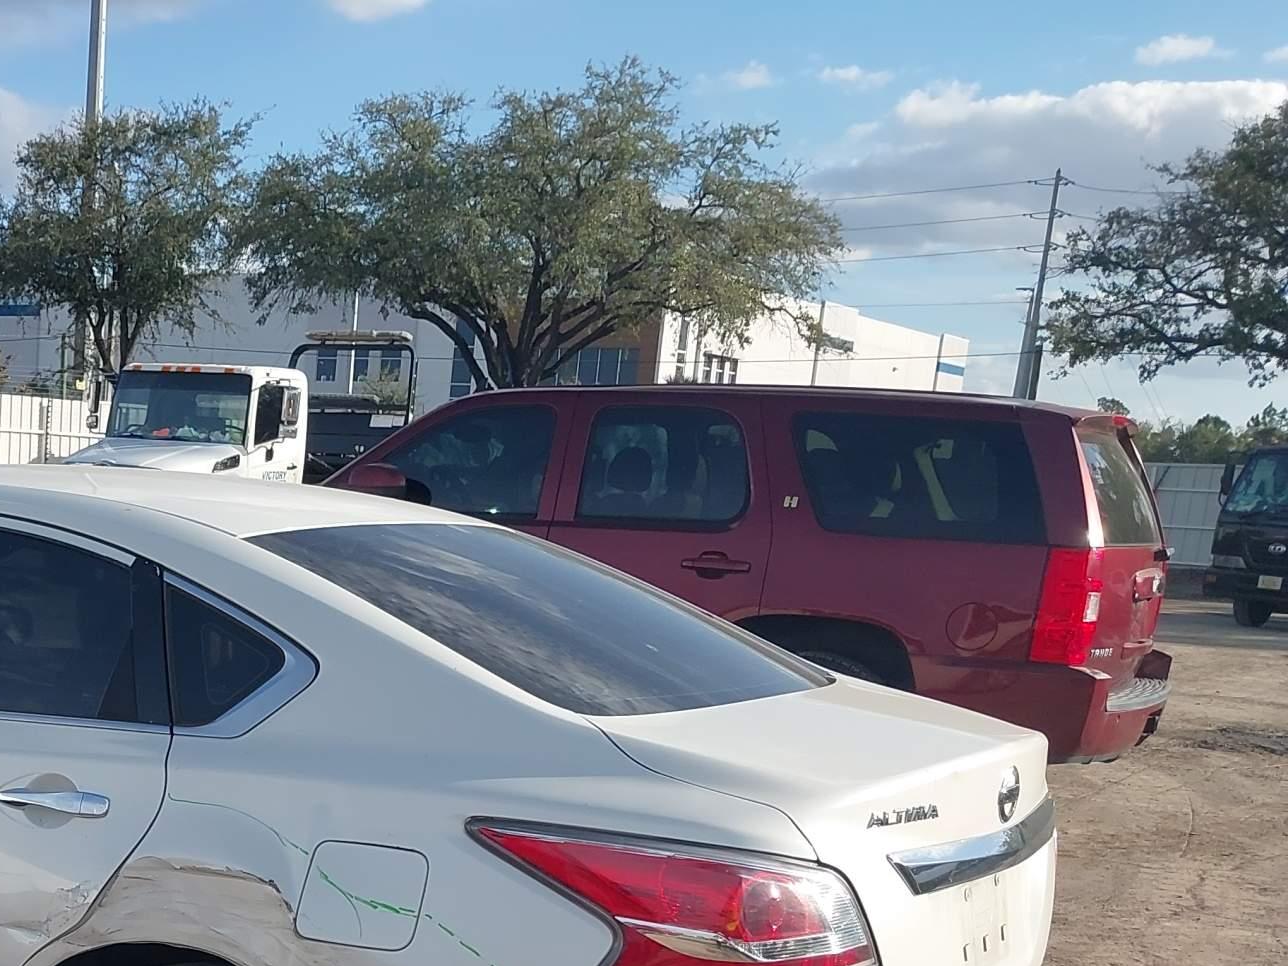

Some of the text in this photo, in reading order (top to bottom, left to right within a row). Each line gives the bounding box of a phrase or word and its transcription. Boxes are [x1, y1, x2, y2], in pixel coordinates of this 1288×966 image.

[262, 471, 288, 481] VICTORY
[1090, 647, 1113, 658] TAHOE
[866, 803, 939, 829] ALTIMA
